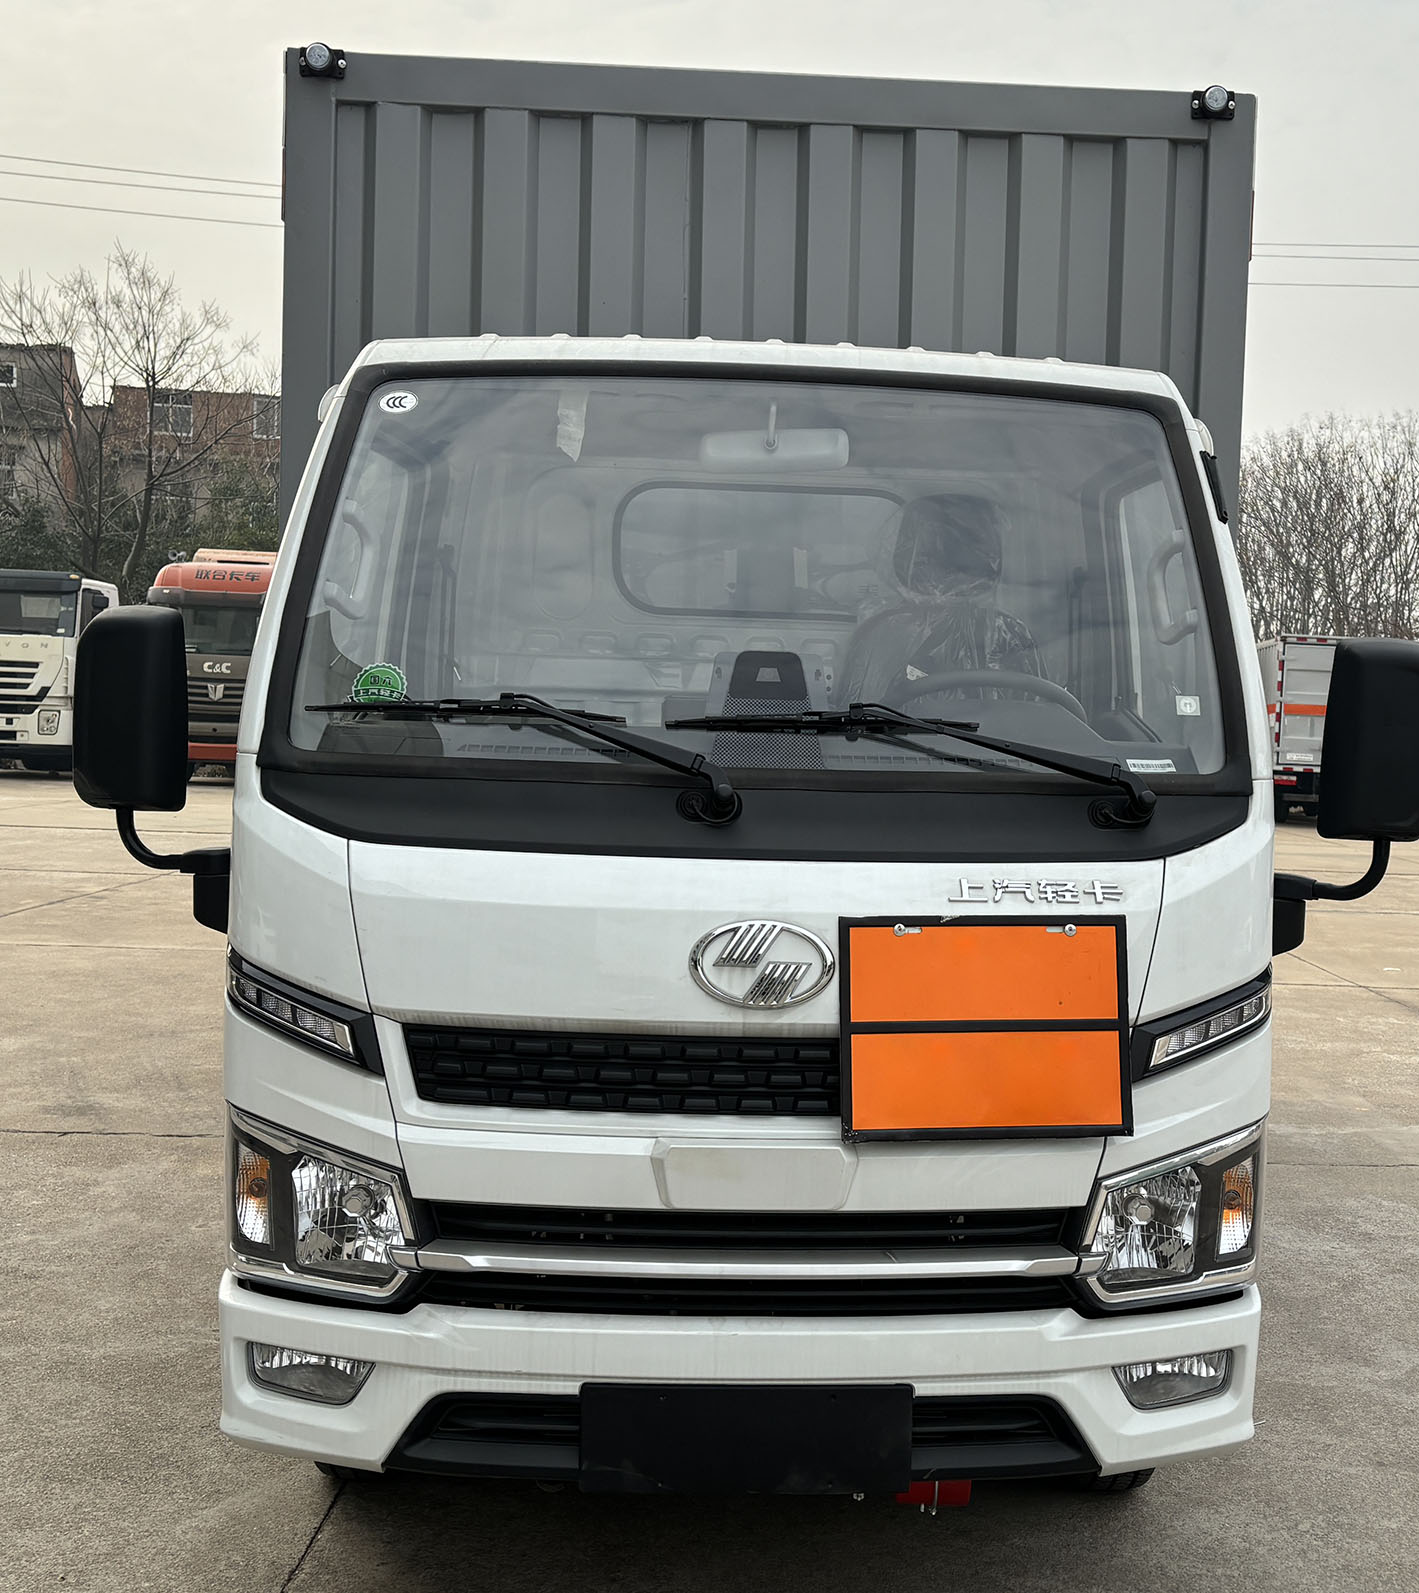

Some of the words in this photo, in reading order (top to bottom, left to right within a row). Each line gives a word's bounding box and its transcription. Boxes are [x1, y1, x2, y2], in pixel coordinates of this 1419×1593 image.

[195, 568, 262, 582] 联合卡车
[202, 661, 232, 674] C&C
[947, 877, 1124, 905] 上汽轻卡
